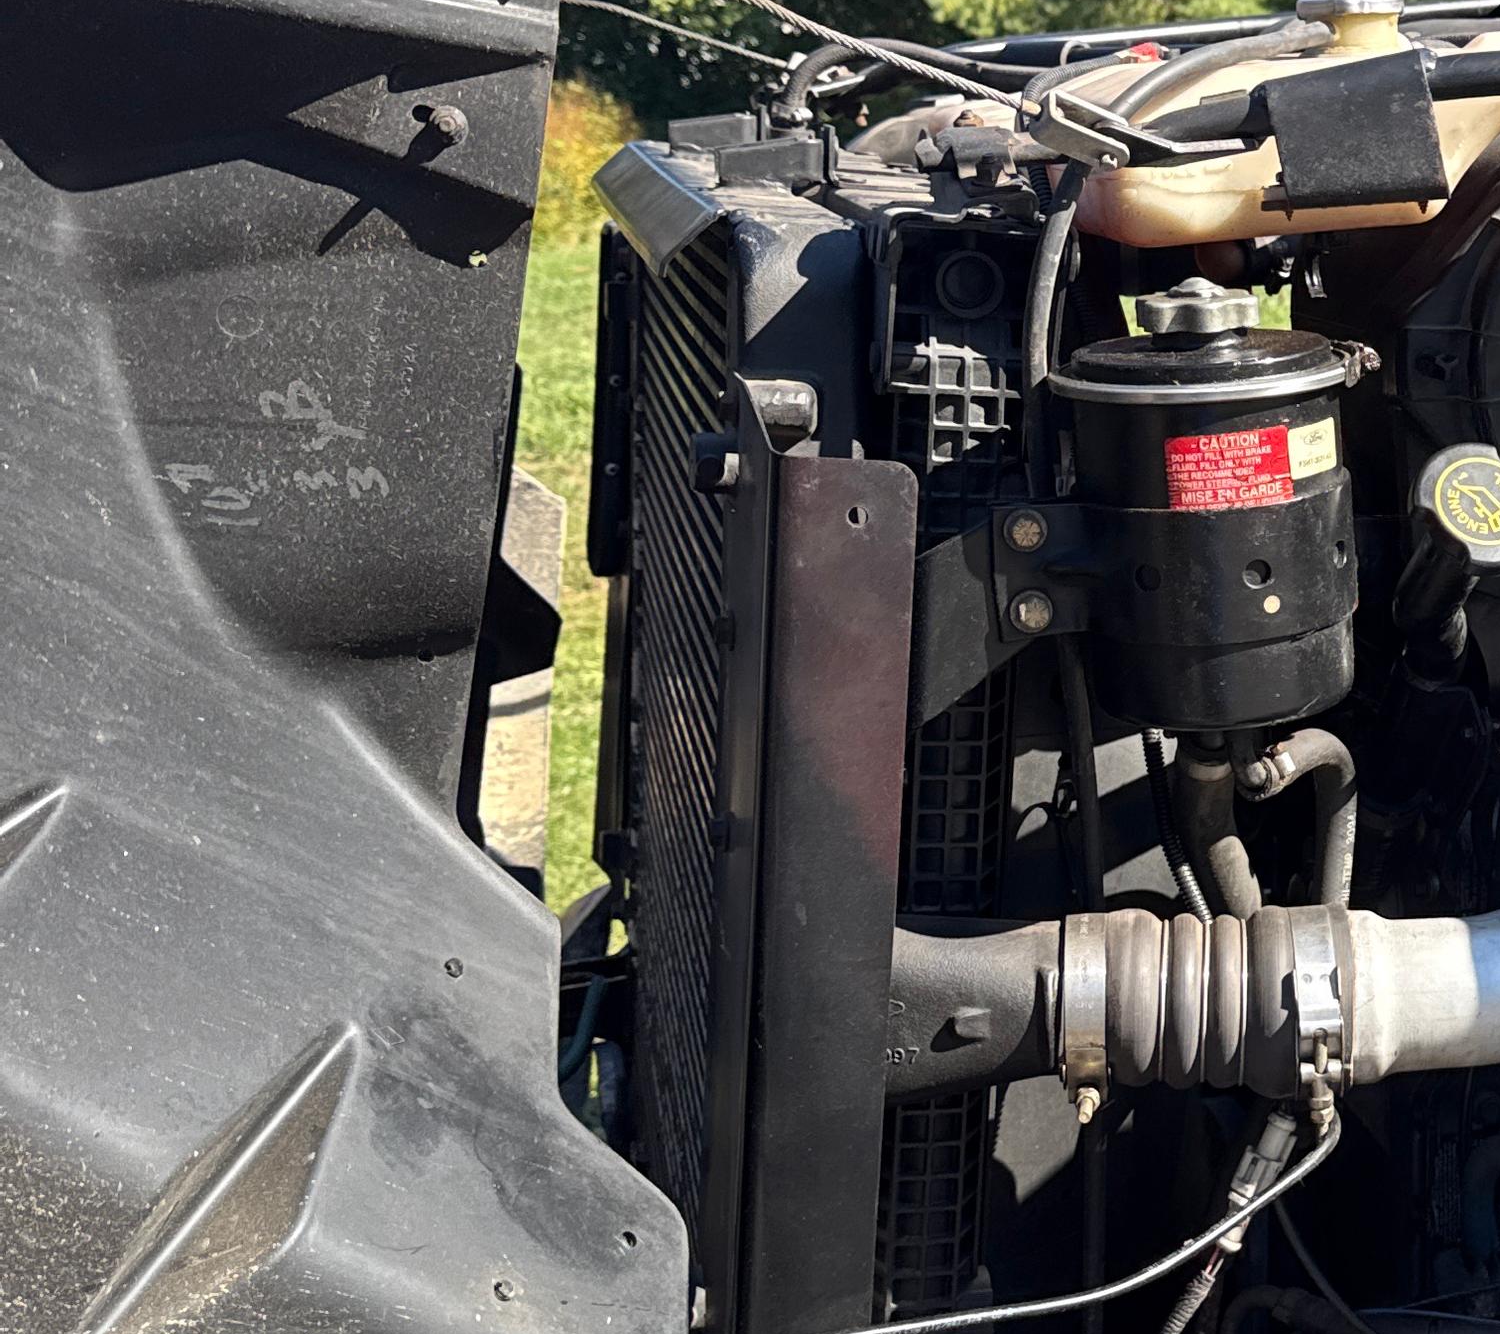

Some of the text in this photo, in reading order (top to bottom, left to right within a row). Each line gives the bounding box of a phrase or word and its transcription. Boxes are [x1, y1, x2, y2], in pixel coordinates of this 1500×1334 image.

[1200, 433, 1259, 450] CAUTION
[1171, 445, 1272, 463] DO NOT FILL WITH BRAKE
[1200, 461, 1217, 470] FILL
[1219, 459, 1240, 469] ONLY
[1242, 457, 1261, 466] WITH
[1173, 472, 1189, 481] THE
[1182, 482, 1283, 504] MISE EN GARDE
[1447, 488, 1489, 534] ENGINE
